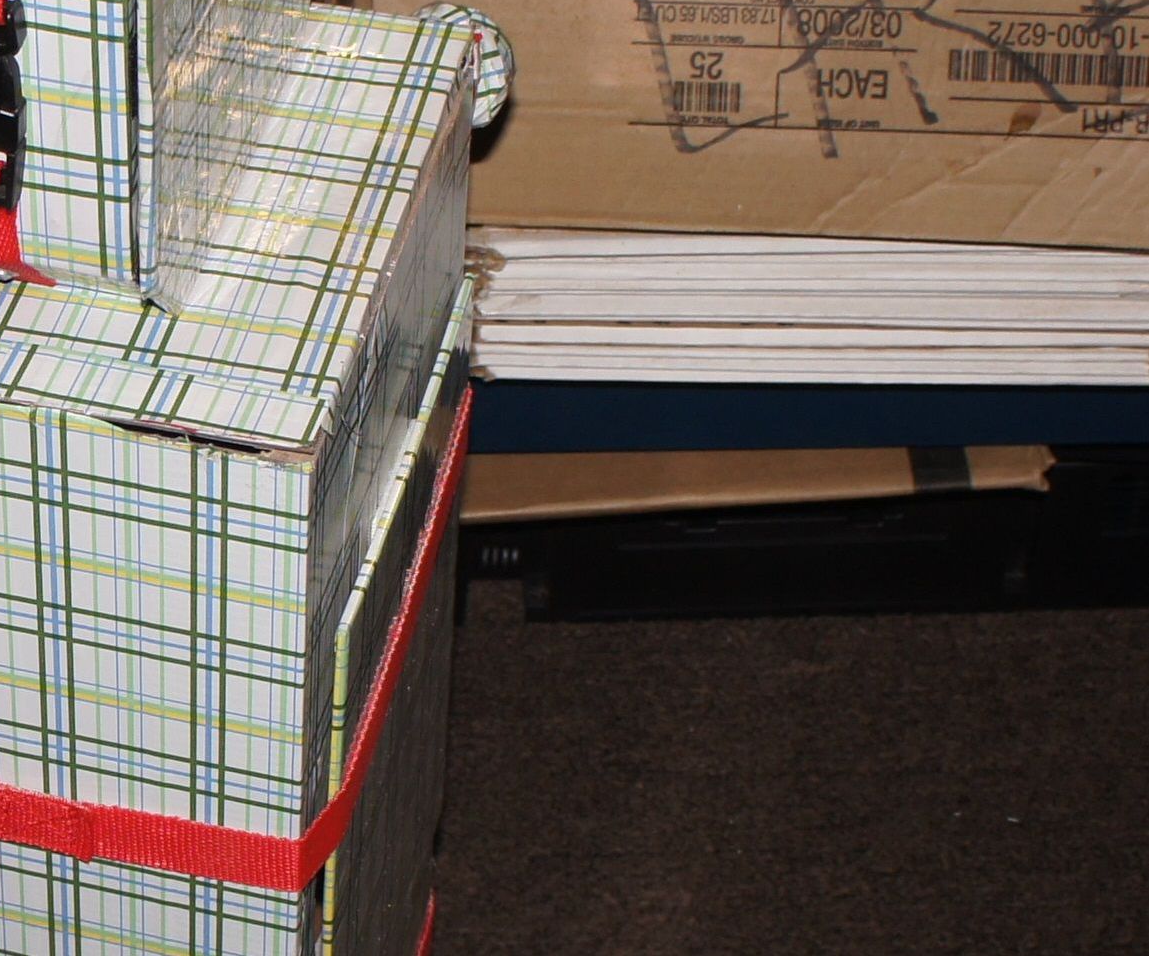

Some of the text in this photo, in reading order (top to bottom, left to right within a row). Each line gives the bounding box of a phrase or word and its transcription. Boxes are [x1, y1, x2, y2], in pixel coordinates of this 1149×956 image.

[680, 6, 738, 23] LBS/1.65
[741, 8, 777, 25] 17.83
[797, 9, 902, 38] 03/2008
[690, 51, 723, 80] 25
[817, 69, 889, 99] EACH
[704, 116, 729, 124] TOTAL
